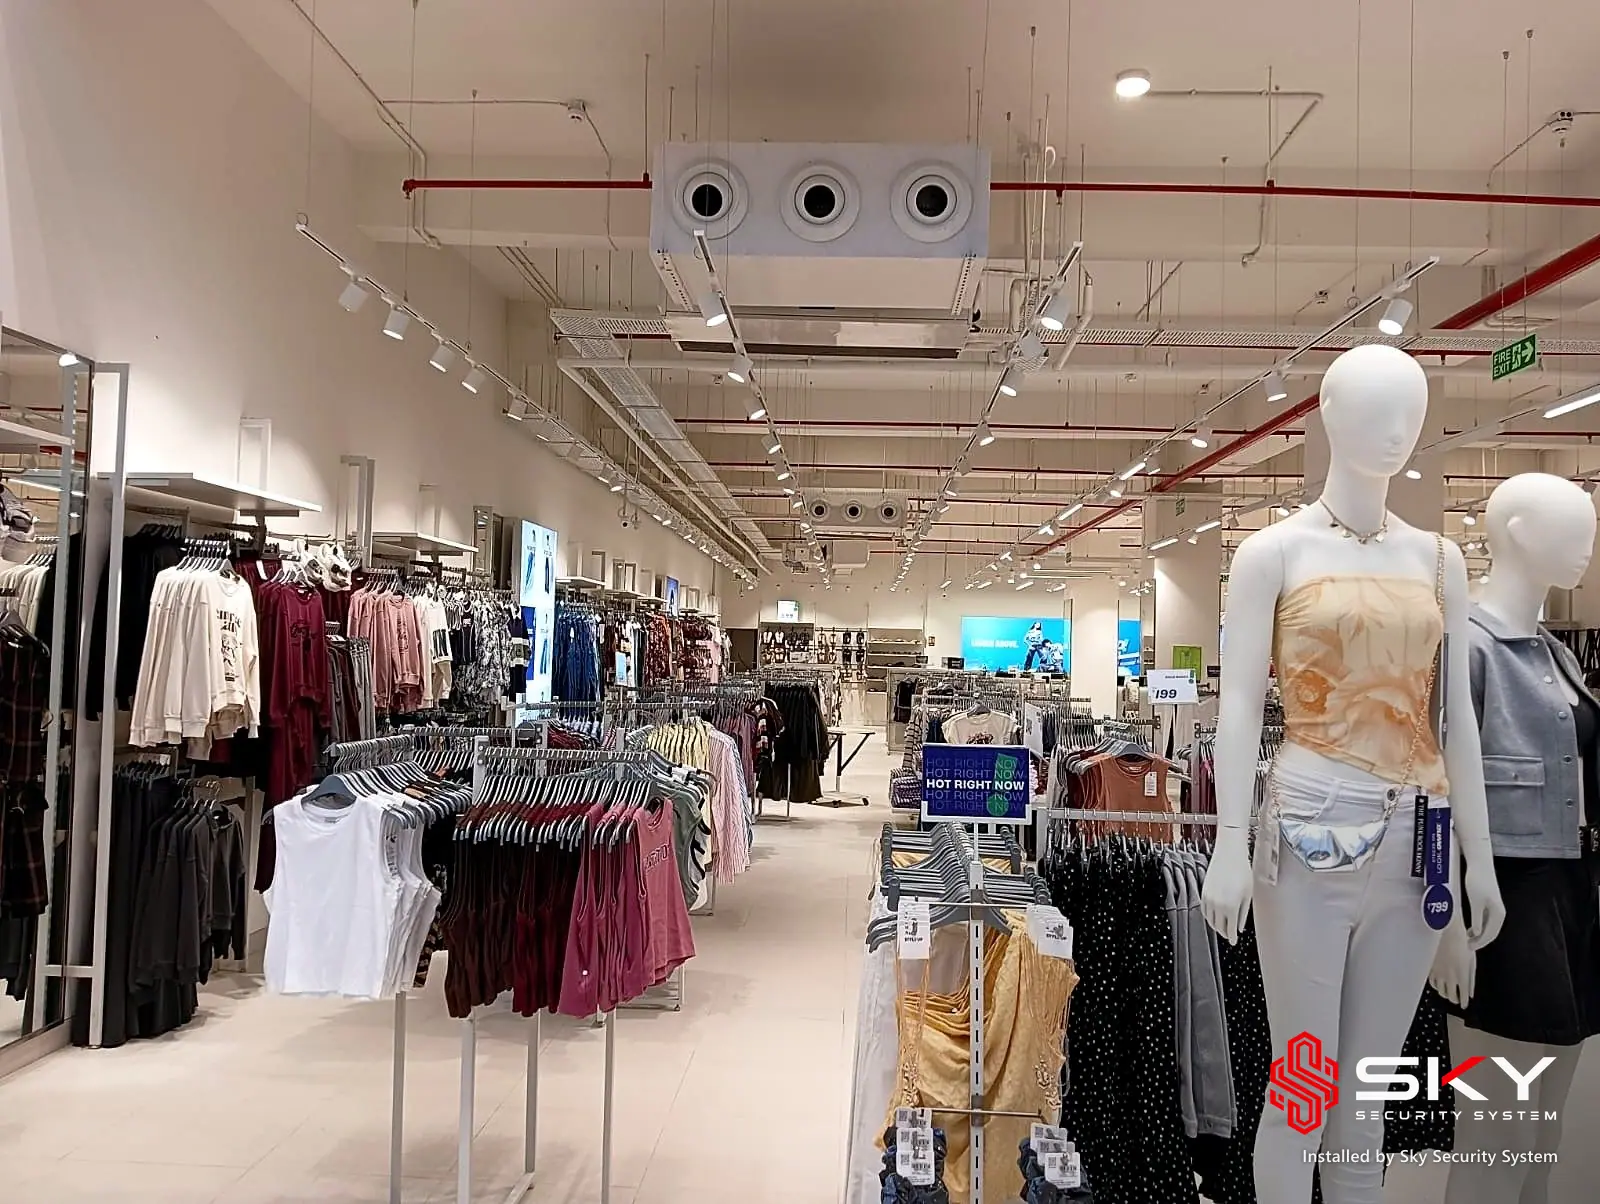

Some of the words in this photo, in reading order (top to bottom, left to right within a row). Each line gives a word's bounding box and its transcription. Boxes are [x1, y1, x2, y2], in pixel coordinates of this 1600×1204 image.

[1493, 348, 1511, 365] FIRE
[1493, 361, 1510, 377] EXIT
[927, 758, 951, 768] HOT
[954, 759, 992, 769] RIGHT
[995, 760, 1025, 770] NOW
[926, 768, 951, 778] HOT
[954, 769, 992, 779] RIGHT
[995, 770, 1024, 780] NOW
[926, 779, 952, 789] HOT
[954, 780, 992, 790] RIGHT
[995, 781, 1025, 790] NOW
[926, 790, 951, 799] HOT
[954, 791, 990, 800] RIGHT
[995, 791, 1024, 801] NOW
